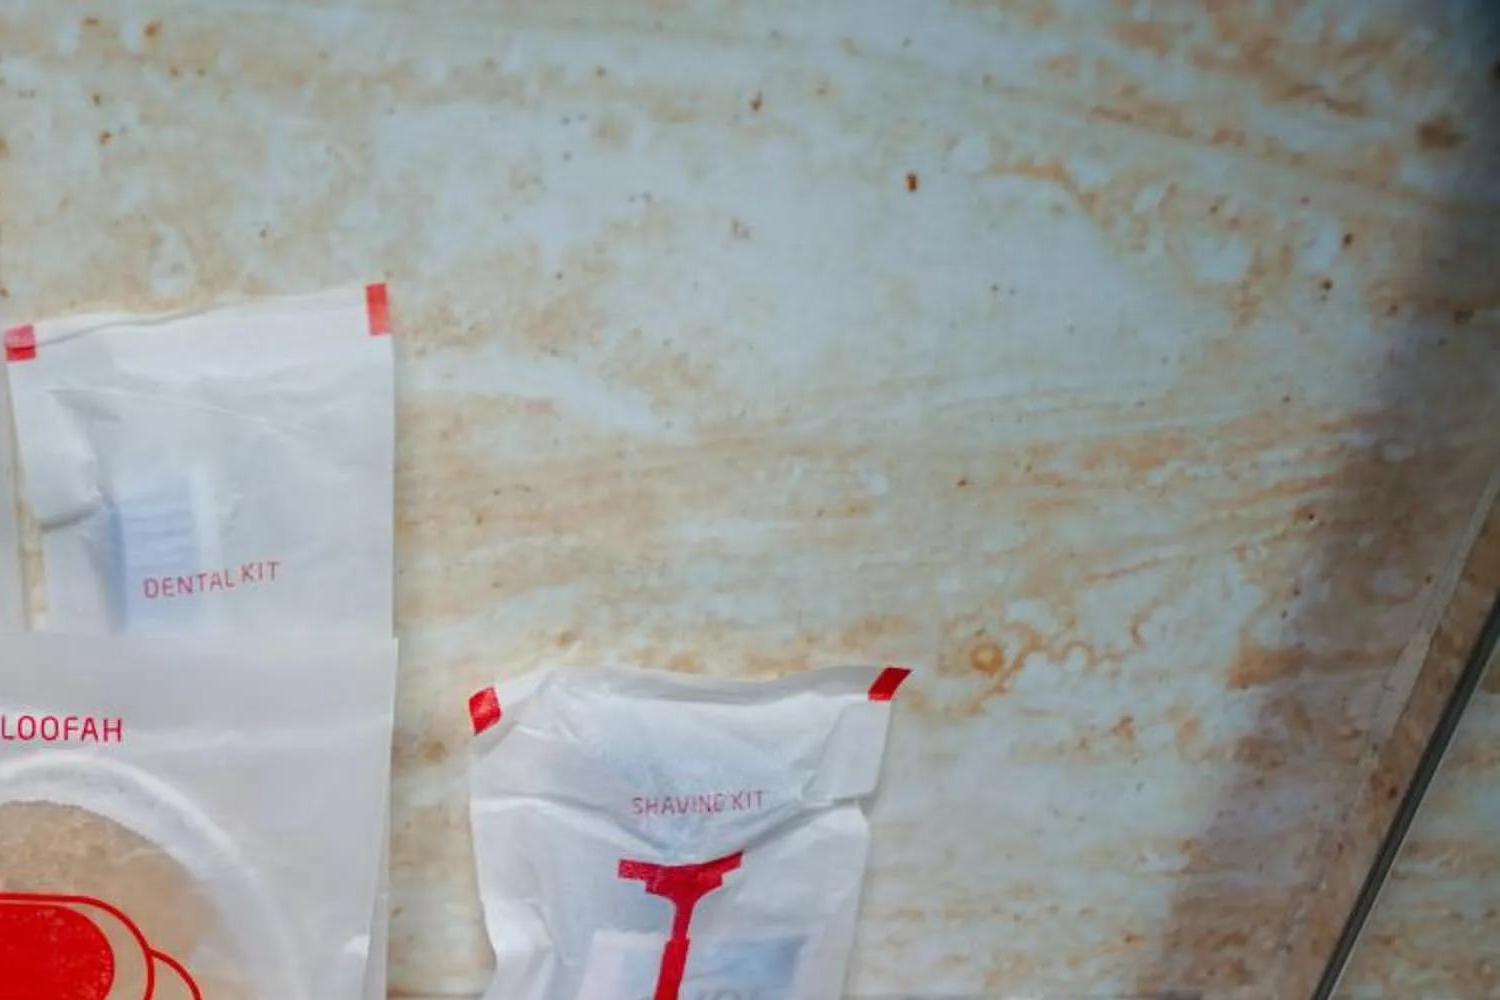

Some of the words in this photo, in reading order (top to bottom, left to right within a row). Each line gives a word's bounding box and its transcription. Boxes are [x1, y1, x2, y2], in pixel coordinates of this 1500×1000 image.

[142, 568, 236, 599] DENTAL
[241, 561, 281, 583] KIT
[0, 714, 122, 742] LOOFAH
[731, 789, 764, 811] KIT
